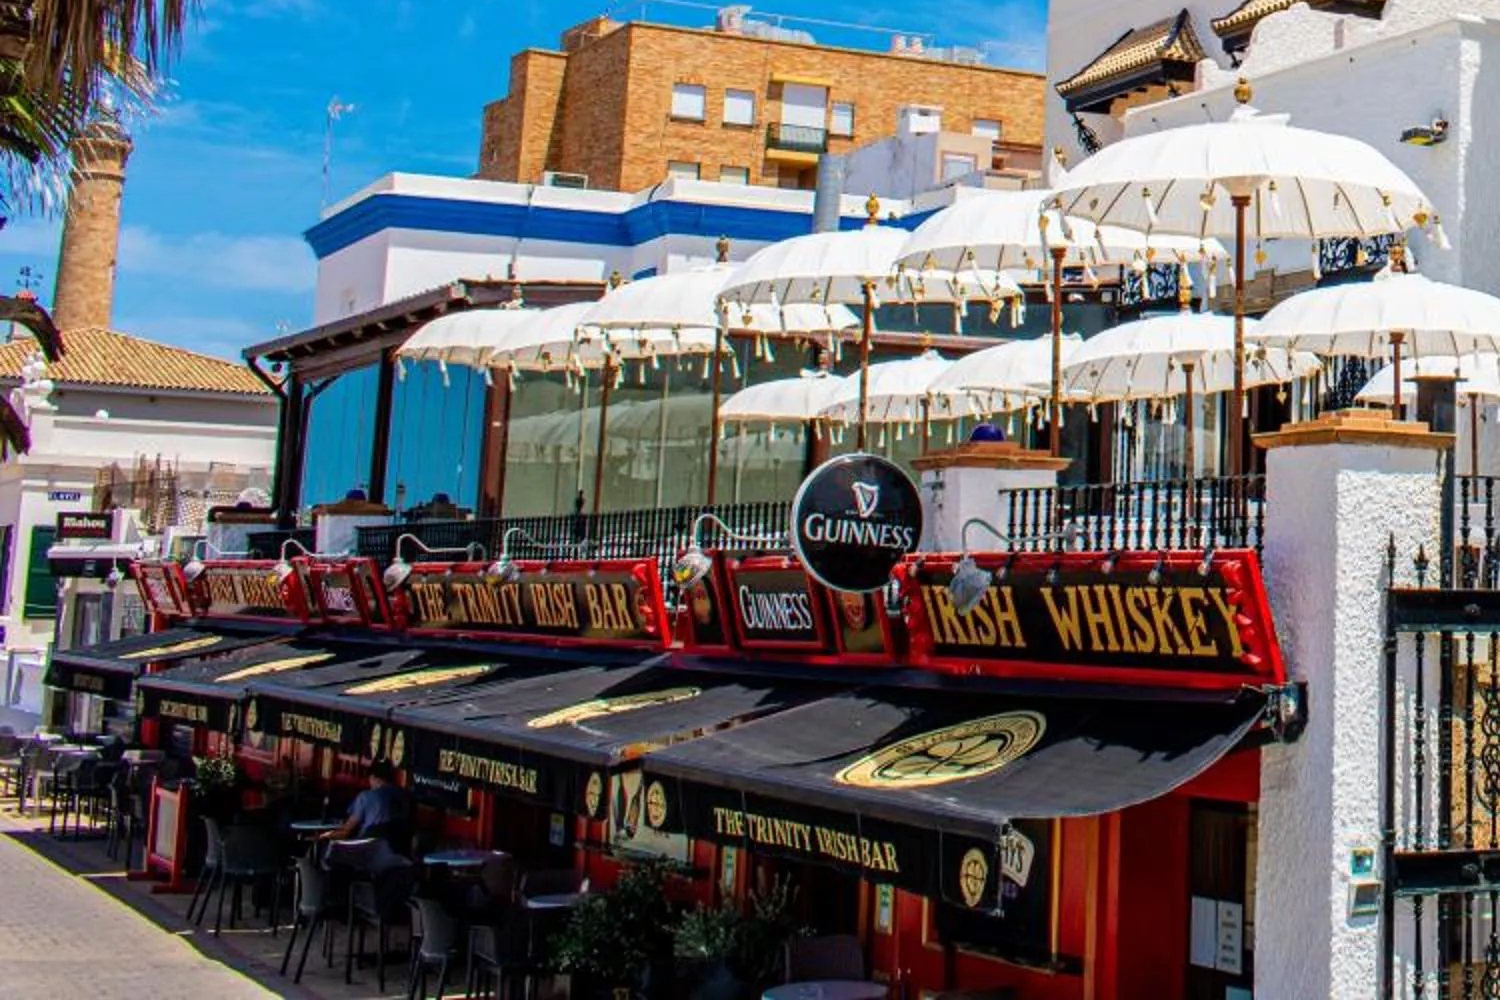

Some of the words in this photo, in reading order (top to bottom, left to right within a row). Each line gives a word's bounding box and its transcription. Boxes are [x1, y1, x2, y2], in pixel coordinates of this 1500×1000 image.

[63, 516, 107, 530] Mahou
[805, 512, 913, 550] GUINNESS
[411, 583, 449, 622] THE
[452, 583, 524, 626] TRINITY
[529, 583, 580, 629] IRISH
[584, 583, 635, 631] BAR
[738, 584, 813, 630] GUINNESS
[1040, 584, 1247, 659] WHISKEY
[713, 807, 745, 836] THE
[746, 812, 812, 852] TRINITY
[814, 825, 860, 864] IRISH
[860, 836, 900, 874] BAR
